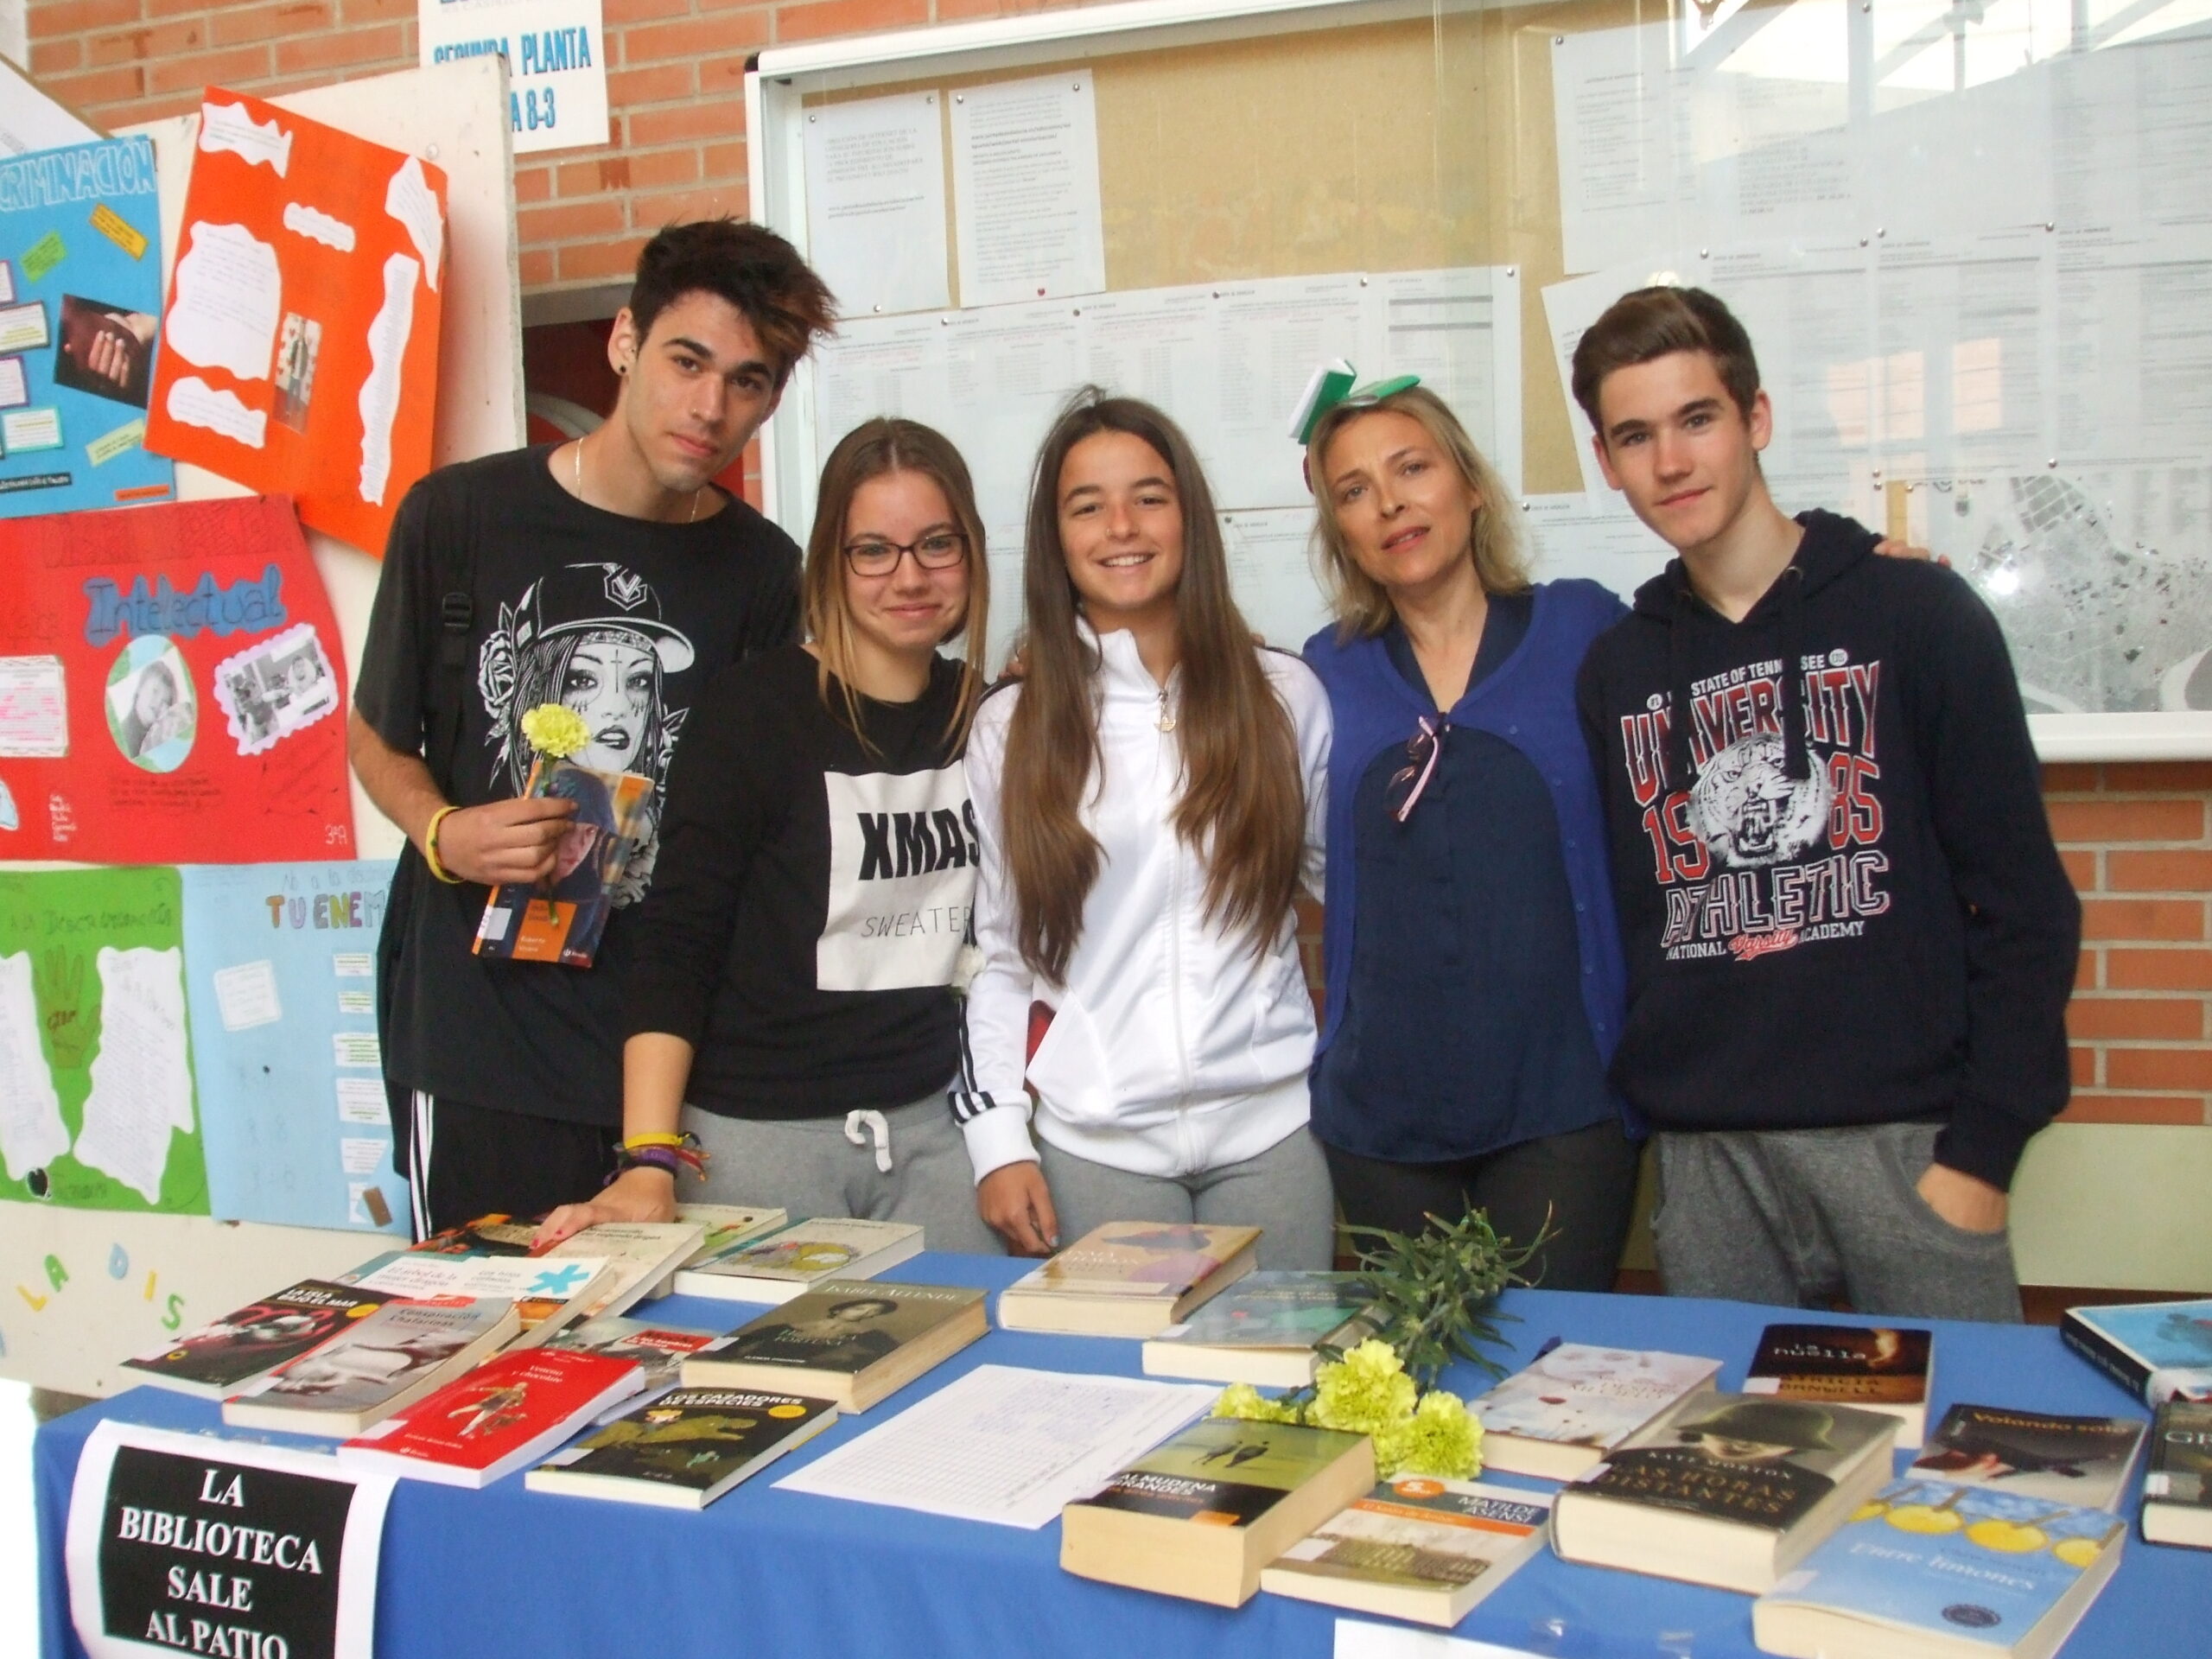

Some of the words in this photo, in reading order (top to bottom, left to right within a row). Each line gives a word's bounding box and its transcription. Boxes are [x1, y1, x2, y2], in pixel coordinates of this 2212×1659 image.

[521, 26, 592, 75] PLANTA
[525, 86, 556, 130] 8-3
[86, 562, 284, 633] Intelectual
[1691, 674, 1729, 696] STATE
[1731, 667, 1746, 687] OF
[856, 798, 981, 880] XMAS
[265, 894, 306, 929] TU
[1661, 849, 1890, 948] ATHLETIC
[1666, 940, 1726, 961] NATIONAL
[1728, 928, 1799, 954] Varsity
[1799, 920, 1865, 944] ACADEMY
[276, 1294, 312, 1303] BAJO
[326, 1299, 359, 1307] MAR
[287, 1288, 304, 1297] LA
[304, 1290, 333, 1300] ISLA
[684, 1399, 766, 1408] ESPECIES
[701, 1394, 804, 1404] CAZADORES
[198, 1468, 245, 1508] LA
[1113, 1478, 1192, 1496] GRANDES
[1119, 1472, 1216, 1492] ALMUDENA
[1458, 1496, 1541, 1516] MATILDE
[1463, 1506, 1533, 1523] ASENSI
[118, 1506, 322, 1574] BIBLIOTECA
[168, 1564, 253, 1612] SALE
[145, 1611, 188, 1648] AL
[189, 1618, 289, 1659] PATIO
